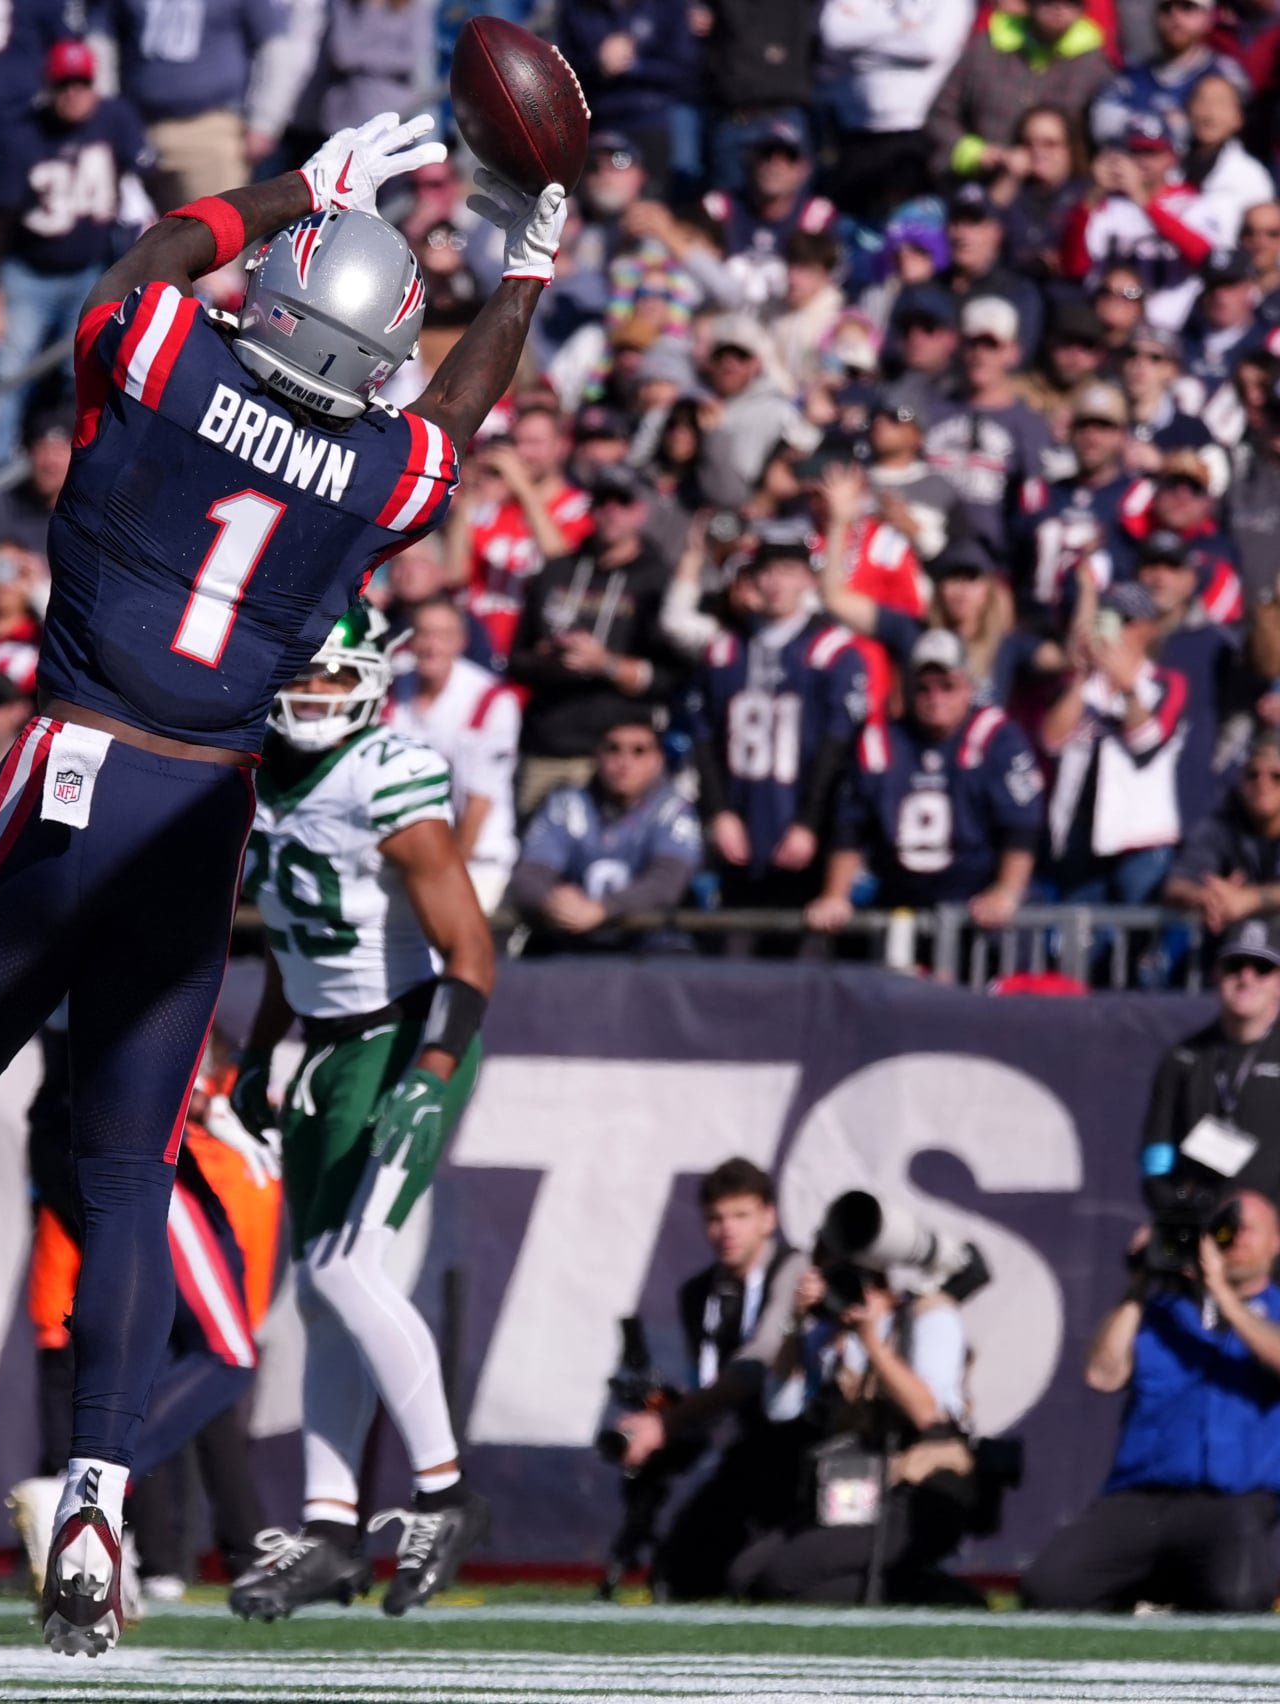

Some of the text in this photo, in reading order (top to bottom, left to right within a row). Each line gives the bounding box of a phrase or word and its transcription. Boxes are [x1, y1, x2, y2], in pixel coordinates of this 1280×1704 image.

[24, 144, 115, 237] 34
[269, 369, 336, 412] PATRIOTS
[319, 353, 337, 376] 1
[197, 383, 356, 503] BROWN
[170, 488, 288, 669] 1
[56, 784, 77, 800] NFL
